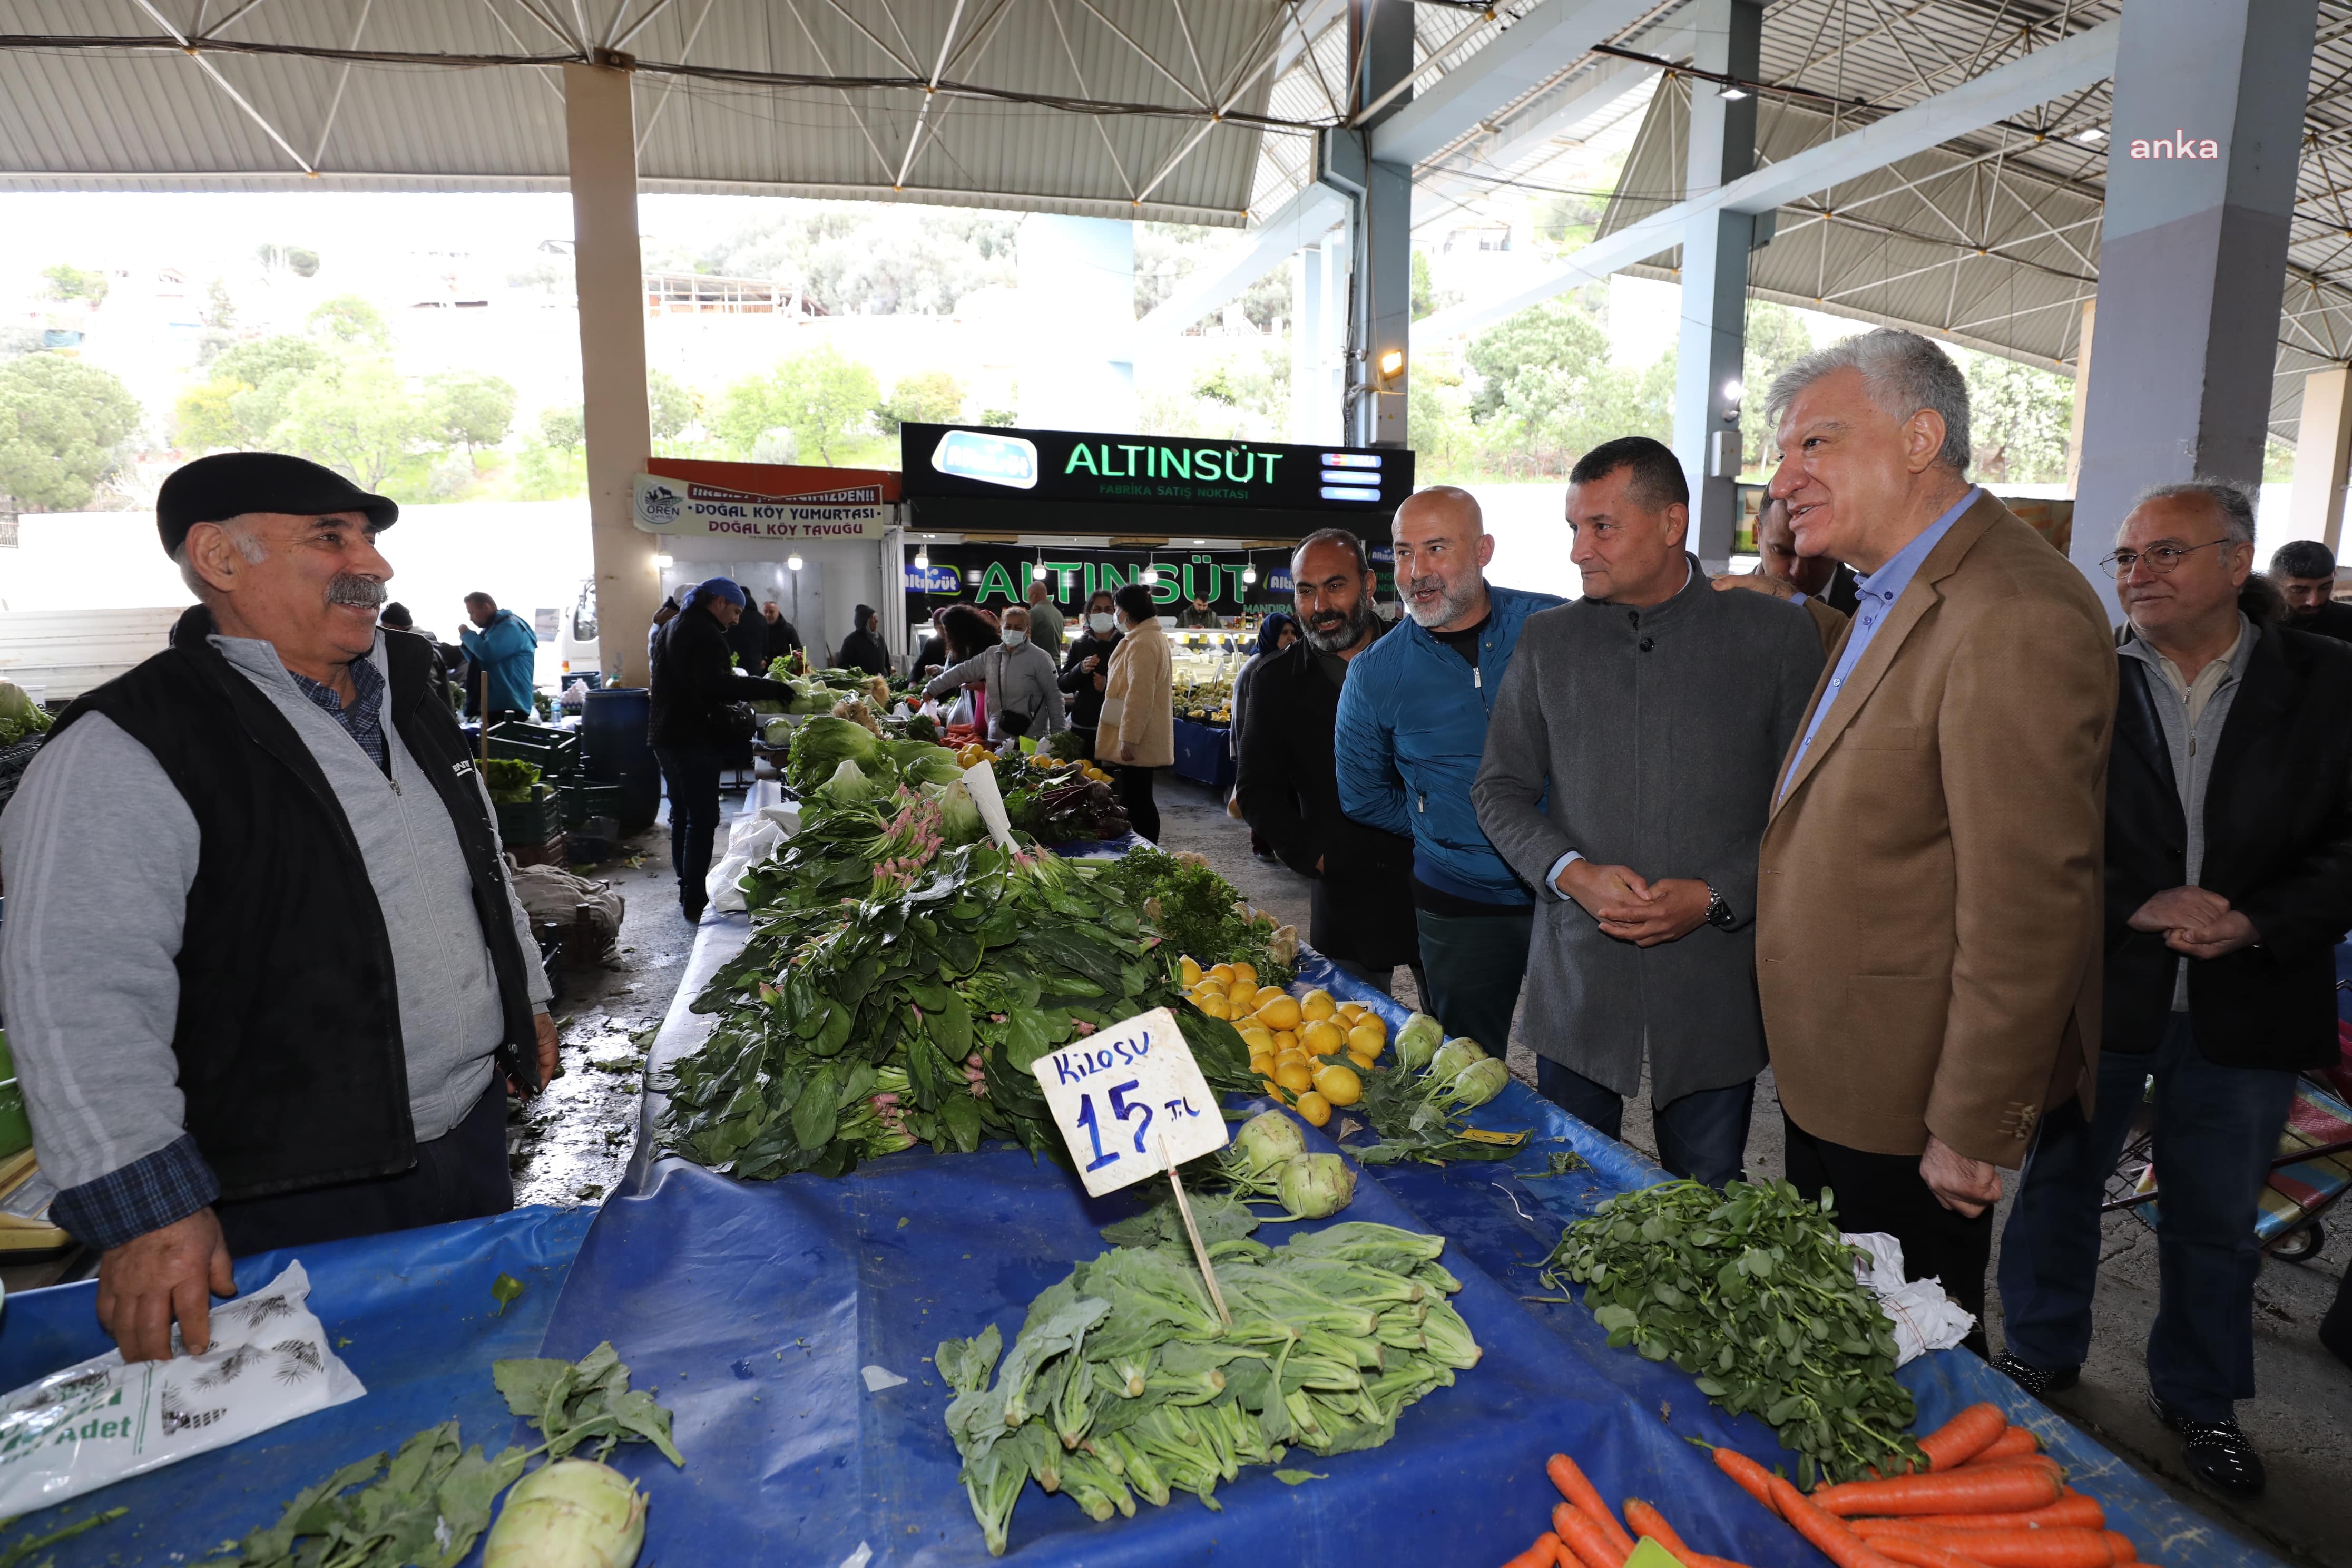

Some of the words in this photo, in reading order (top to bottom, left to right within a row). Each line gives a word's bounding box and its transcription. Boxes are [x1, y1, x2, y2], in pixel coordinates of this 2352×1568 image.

[1064, 442, 1283, 484] ALTINSÜT
[1100, 483, 1151, 496] FABRİKA
[1157, 486, 1192, 499] SATIŞ
[1198, 488, 1249, 499] NOKTASI
[695, 503, 747, 518] DOĞAL
[753, 505, 784, 520] KÖY
[790, 508, 874, 521] YUMURTASI
[709, 521, 761, 534] DOĞAL
[767, 523, 798, 536] KÖY
[802, 523, 863, 536] TAVUĞU
[974, 555, 1256, 604] ALTINSÜT
[1243, 603, 1293, 614] MANDIRA
[1077, 1079, 1153, 1173] 15
[55, 1416, 132, 1445] Adet
